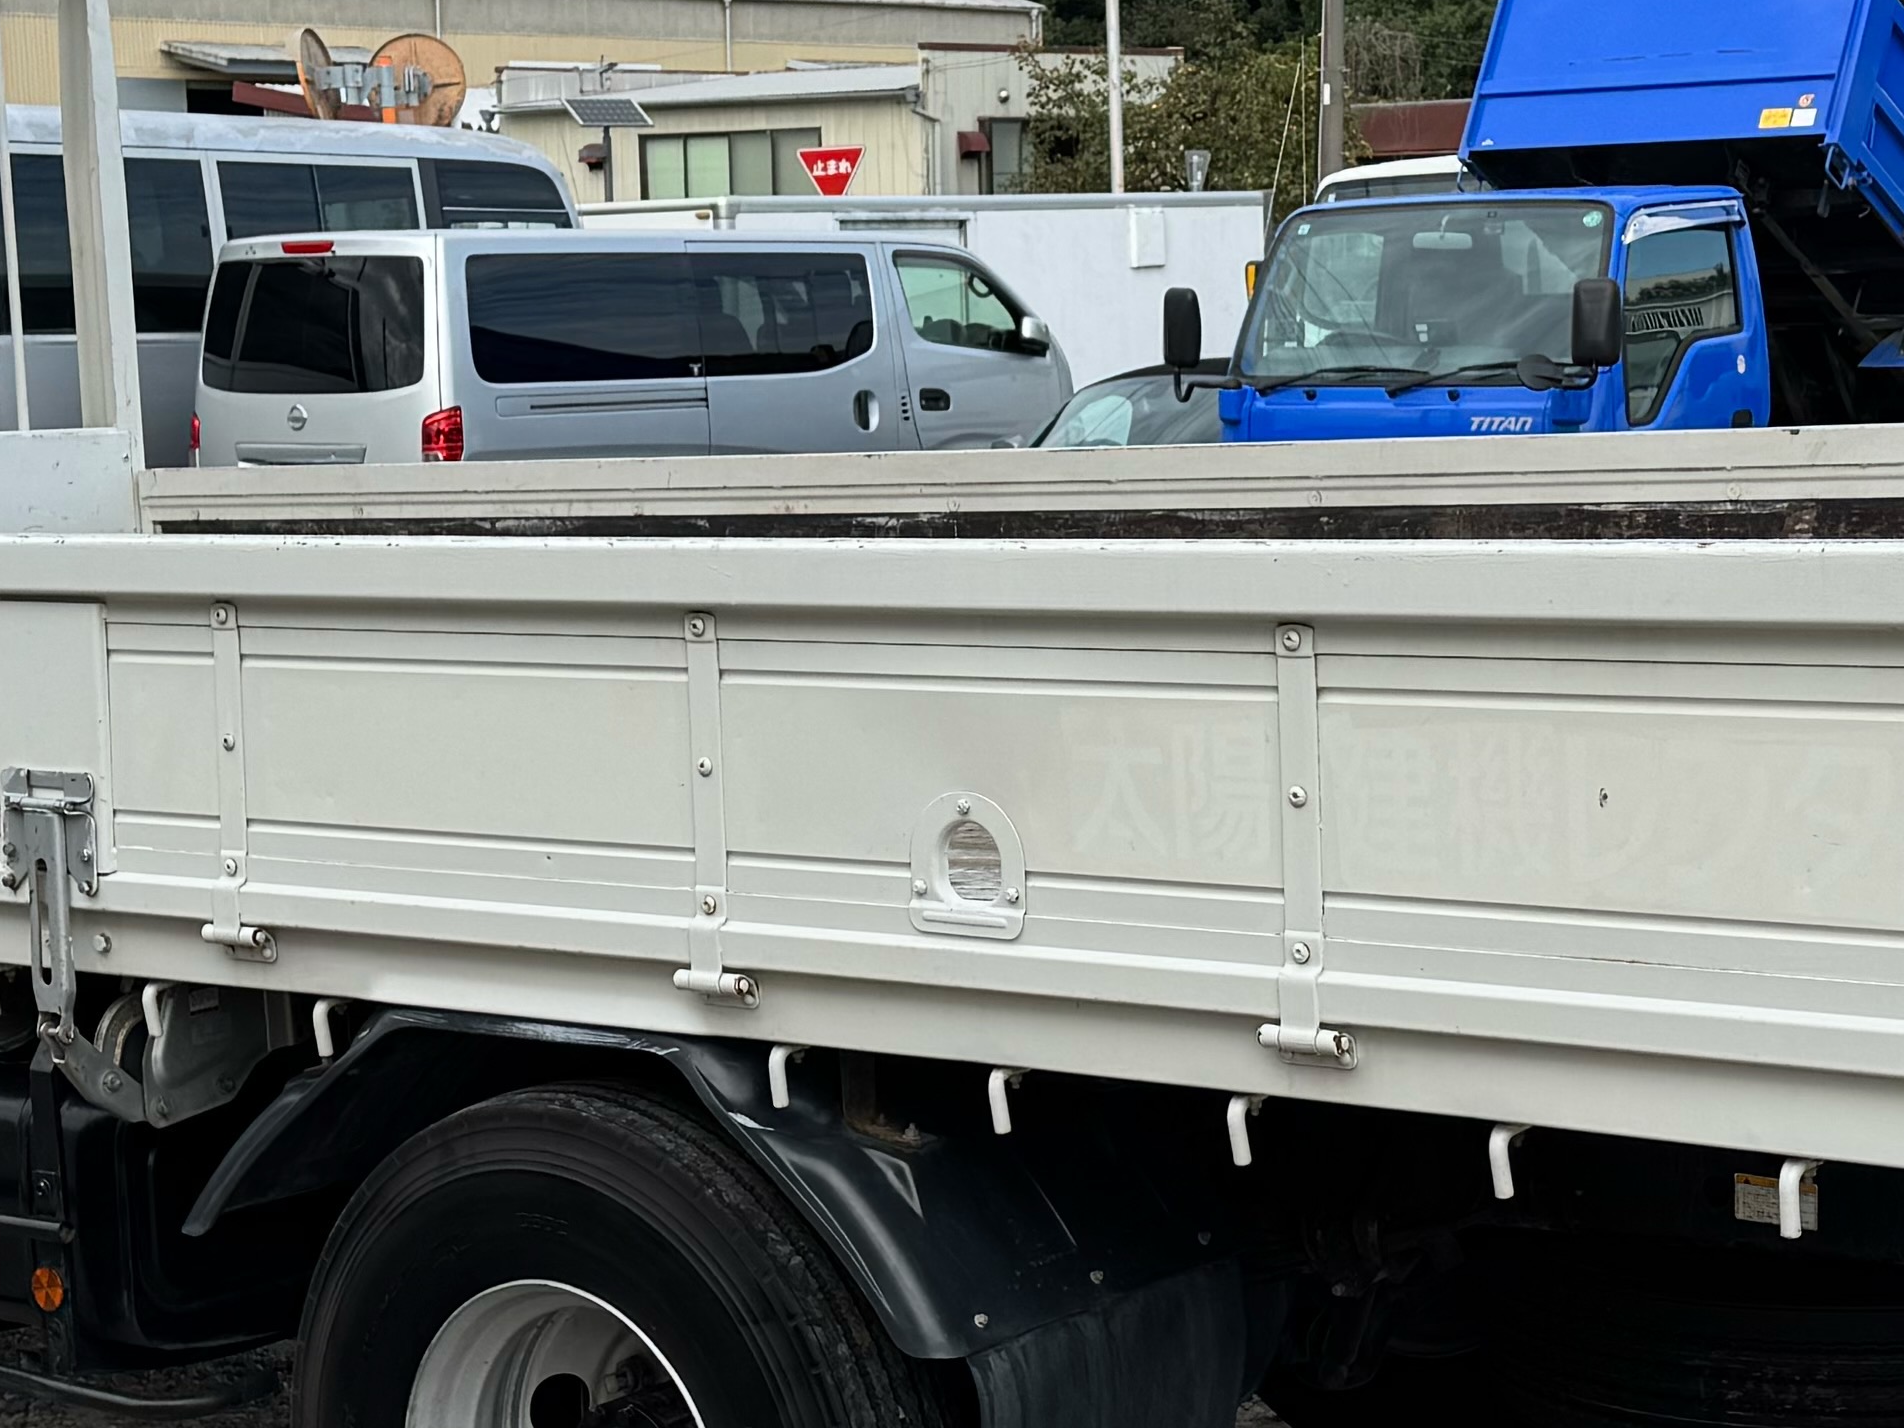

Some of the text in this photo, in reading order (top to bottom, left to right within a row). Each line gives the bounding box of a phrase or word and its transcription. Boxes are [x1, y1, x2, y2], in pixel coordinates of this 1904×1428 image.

[812, 158, 852, 176] 止まれ
[1470, 416, 1533, 432] TITAN
